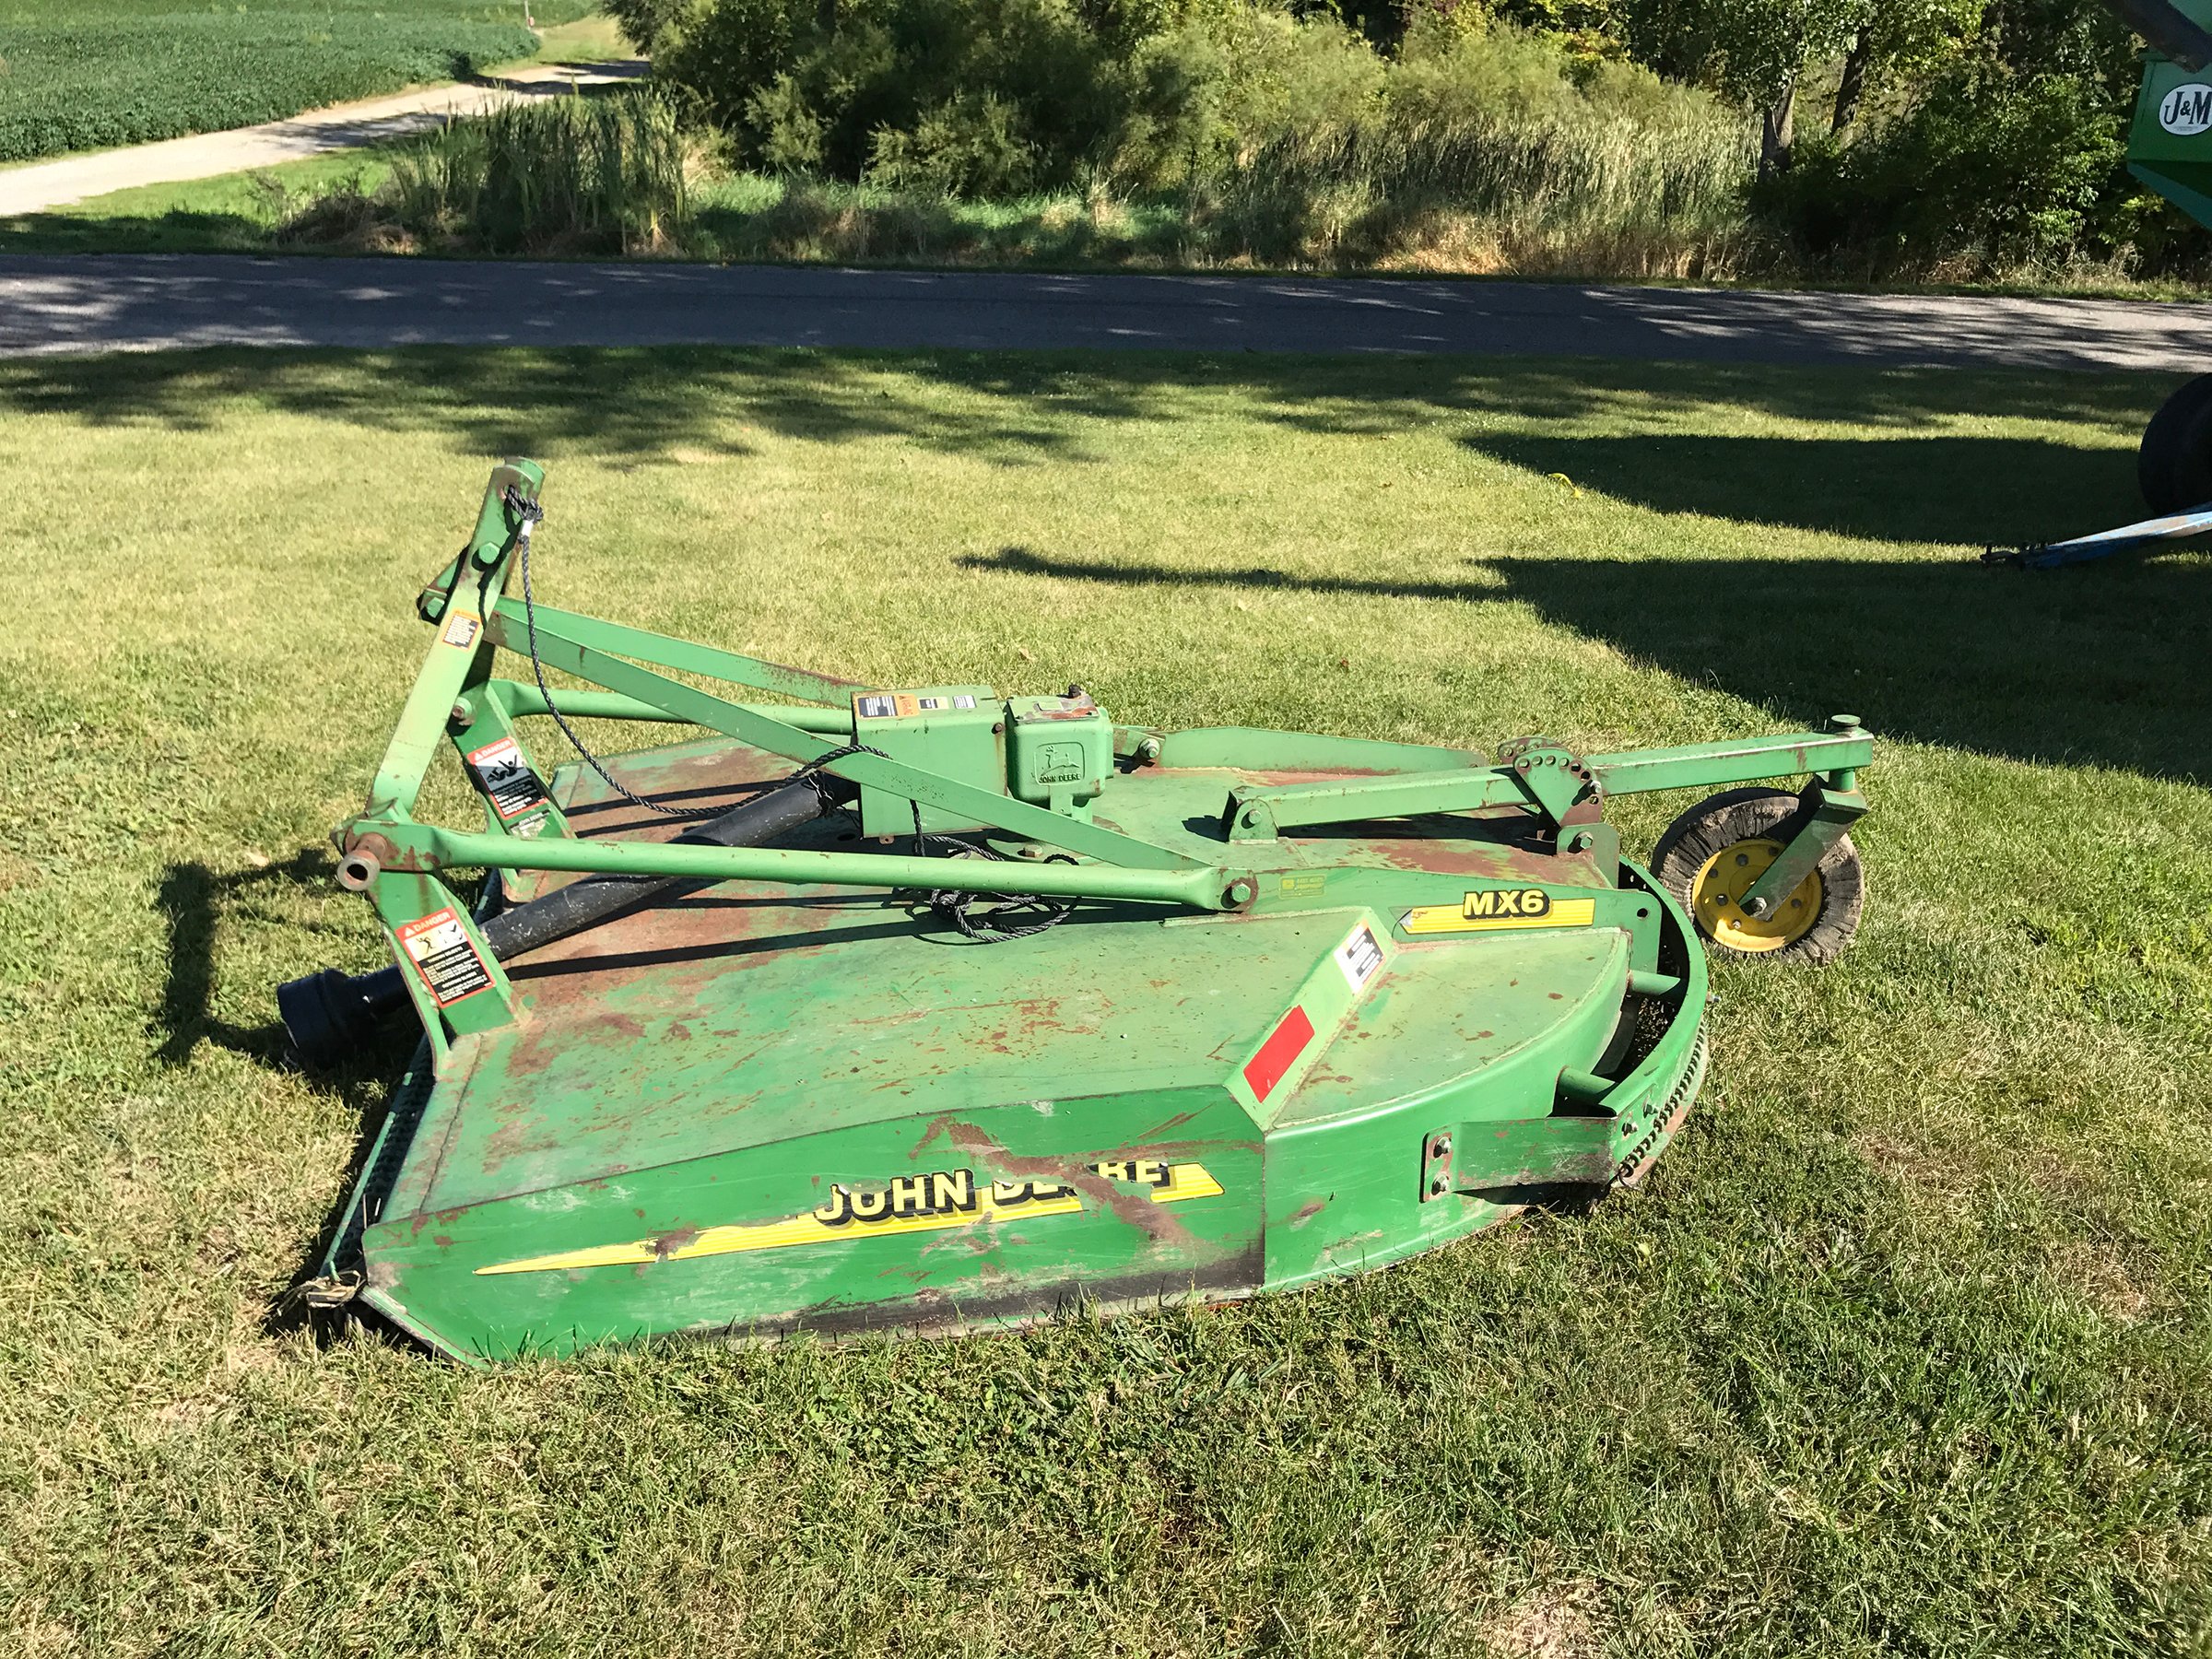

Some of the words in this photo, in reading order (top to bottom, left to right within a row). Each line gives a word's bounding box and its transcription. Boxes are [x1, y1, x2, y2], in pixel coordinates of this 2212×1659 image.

[2163, 90, 2212, 125] J&M
[481, 739, 512, 758] DANGER
[1039, 775, 1056, 783] JOHN
[1058, 773, 1081, 782] DEERE
[1463, 888, 1551, 920] MX6
[412, 912, 452, 932] DANGER
[813, 1169, 974, 1230] JOHN
[993, 1159, 1171, 1206] DRE
